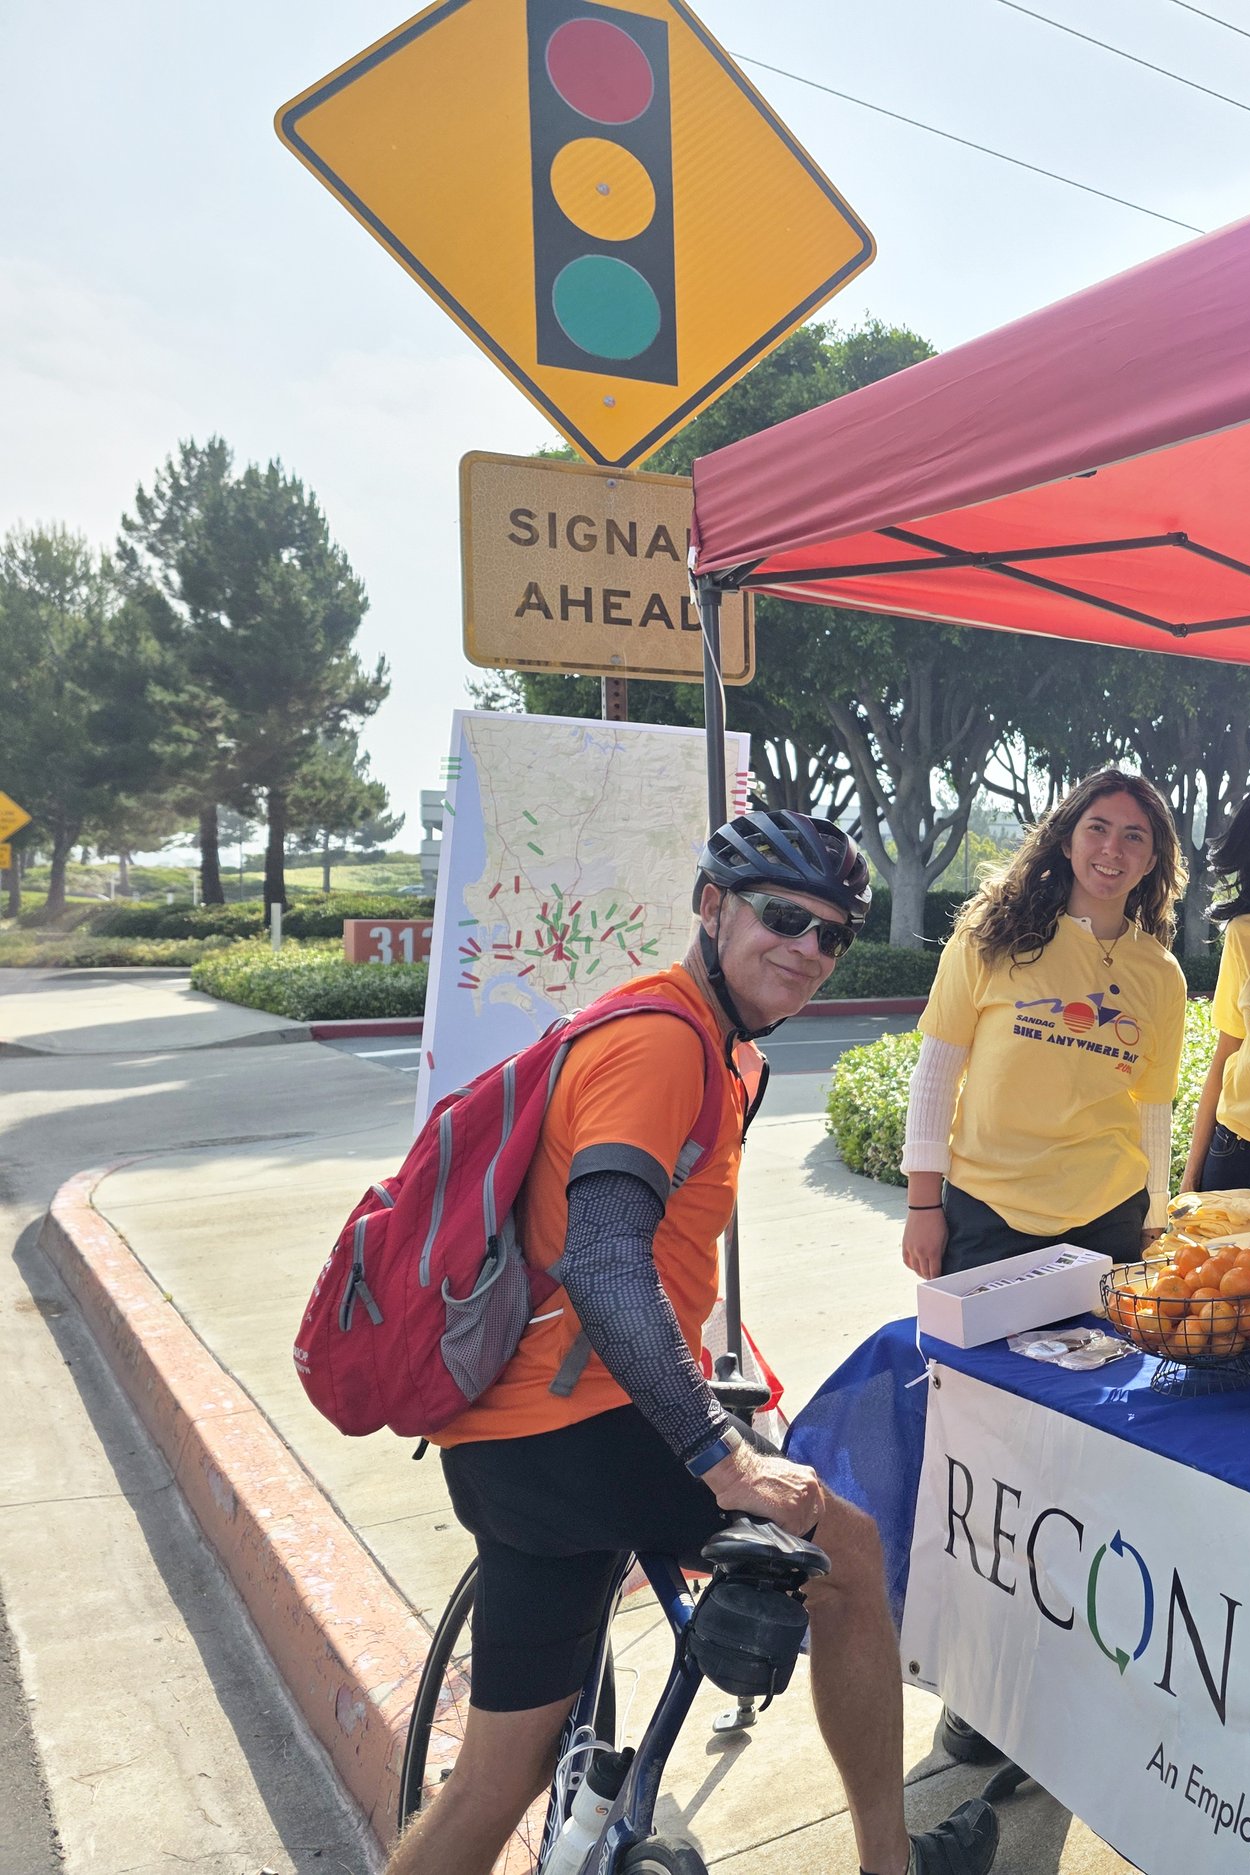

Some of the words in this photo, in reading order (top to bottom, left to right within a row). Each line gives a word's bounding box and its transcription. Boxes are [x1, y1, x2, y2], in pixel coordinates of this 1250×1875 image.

[507, 508, 691, 562] SIGNA
[1013, 1024, 1042, 1040] BIKE
[1046, 1033, 1119, 1058] ANYWHERE
[1122, 1050, 1139, 1064] DAY
[1016, 1014, 1056, 1028] SANDAG
[944, 1453, 1243, 1727] RECON
[1146, 1741, 1178, 1790] An
